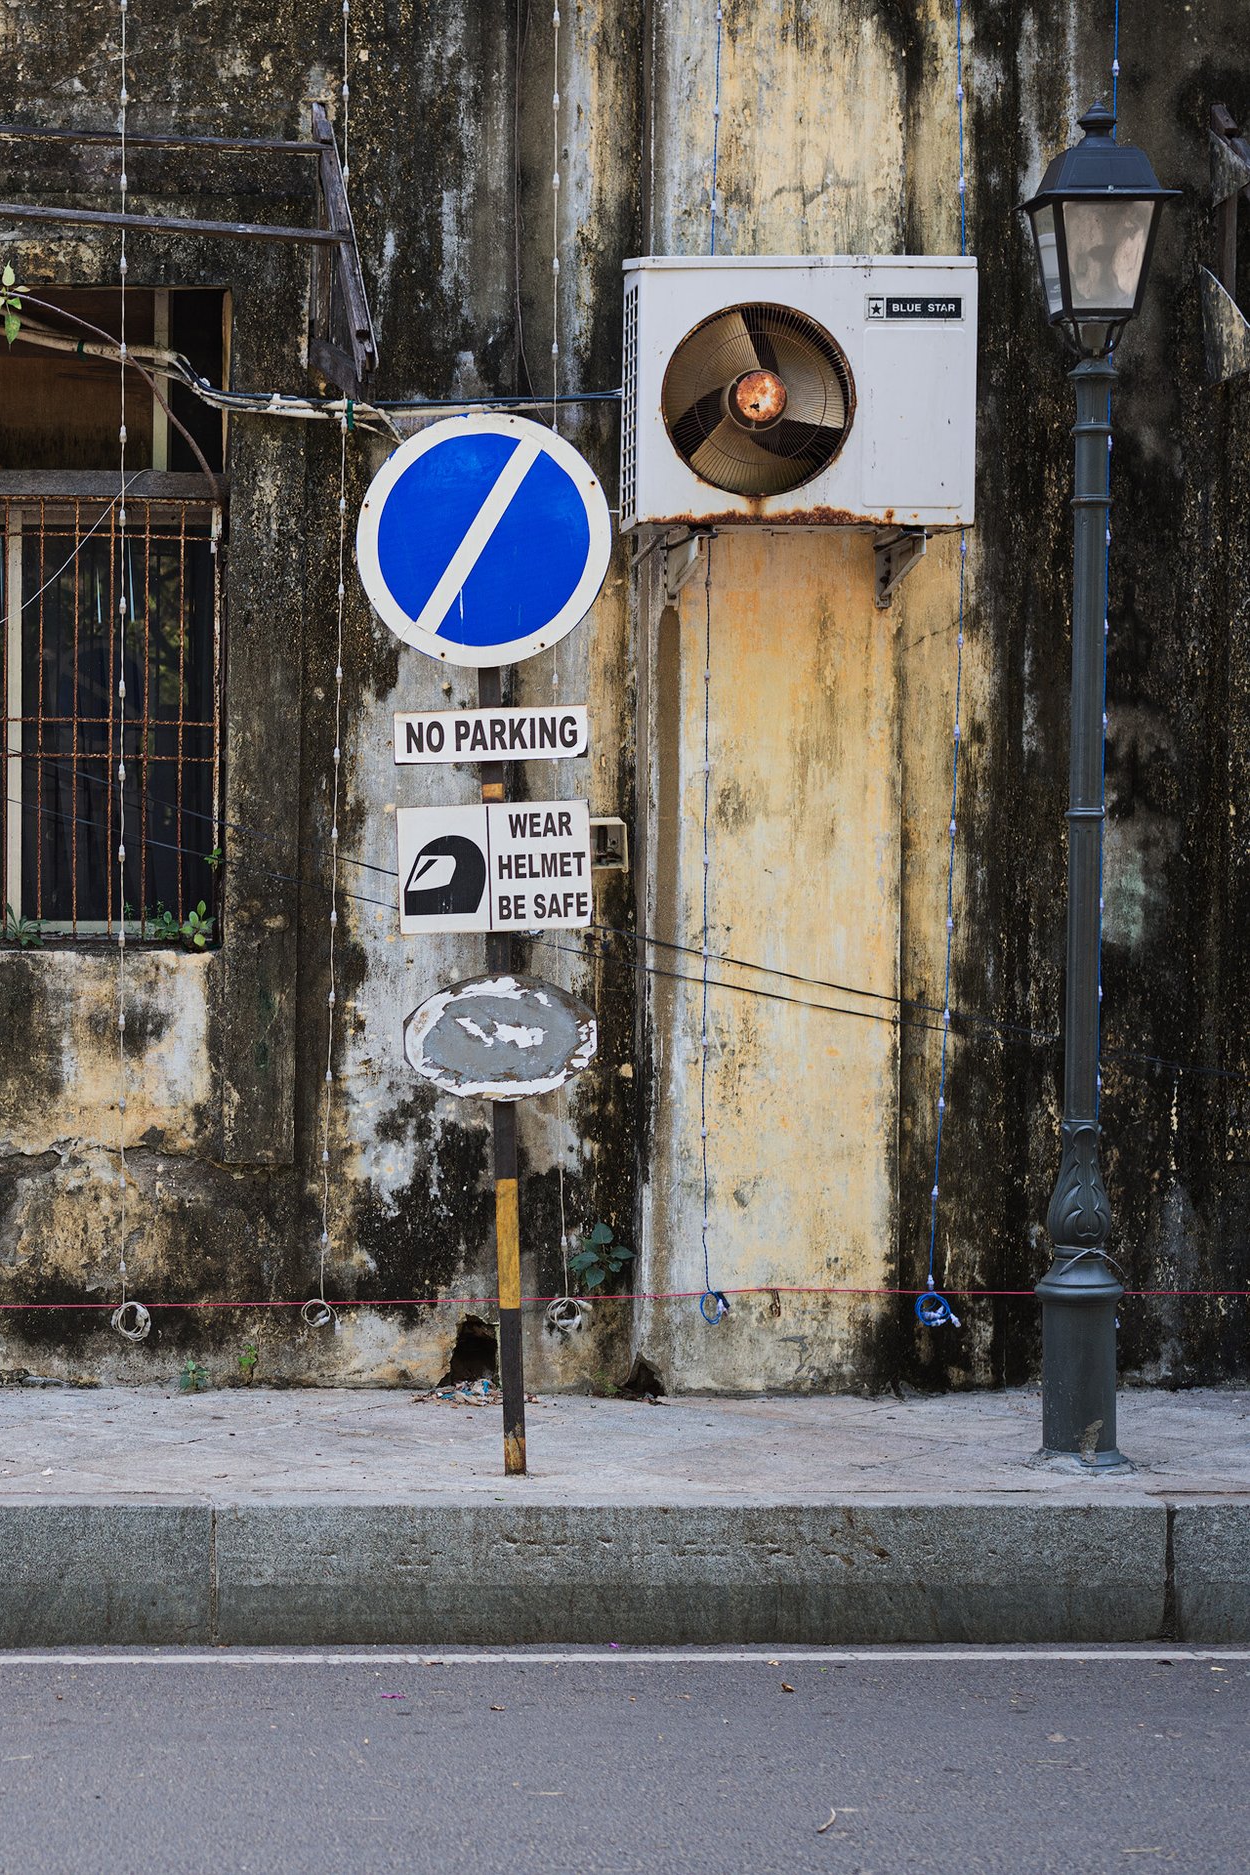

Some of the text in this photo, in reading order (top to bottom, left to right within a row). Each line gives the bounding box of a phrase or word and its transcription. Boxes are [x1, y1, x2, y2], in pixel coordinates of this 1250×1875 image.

[892, 303, 956, 312] BLUE STAR
[406, 715, 578, 754] NO PARKING
[508, 811, 572, 839] WEAR
[498, 852, 586, 880] HELMET
[498, 891, 588, 920] BE SAFE
